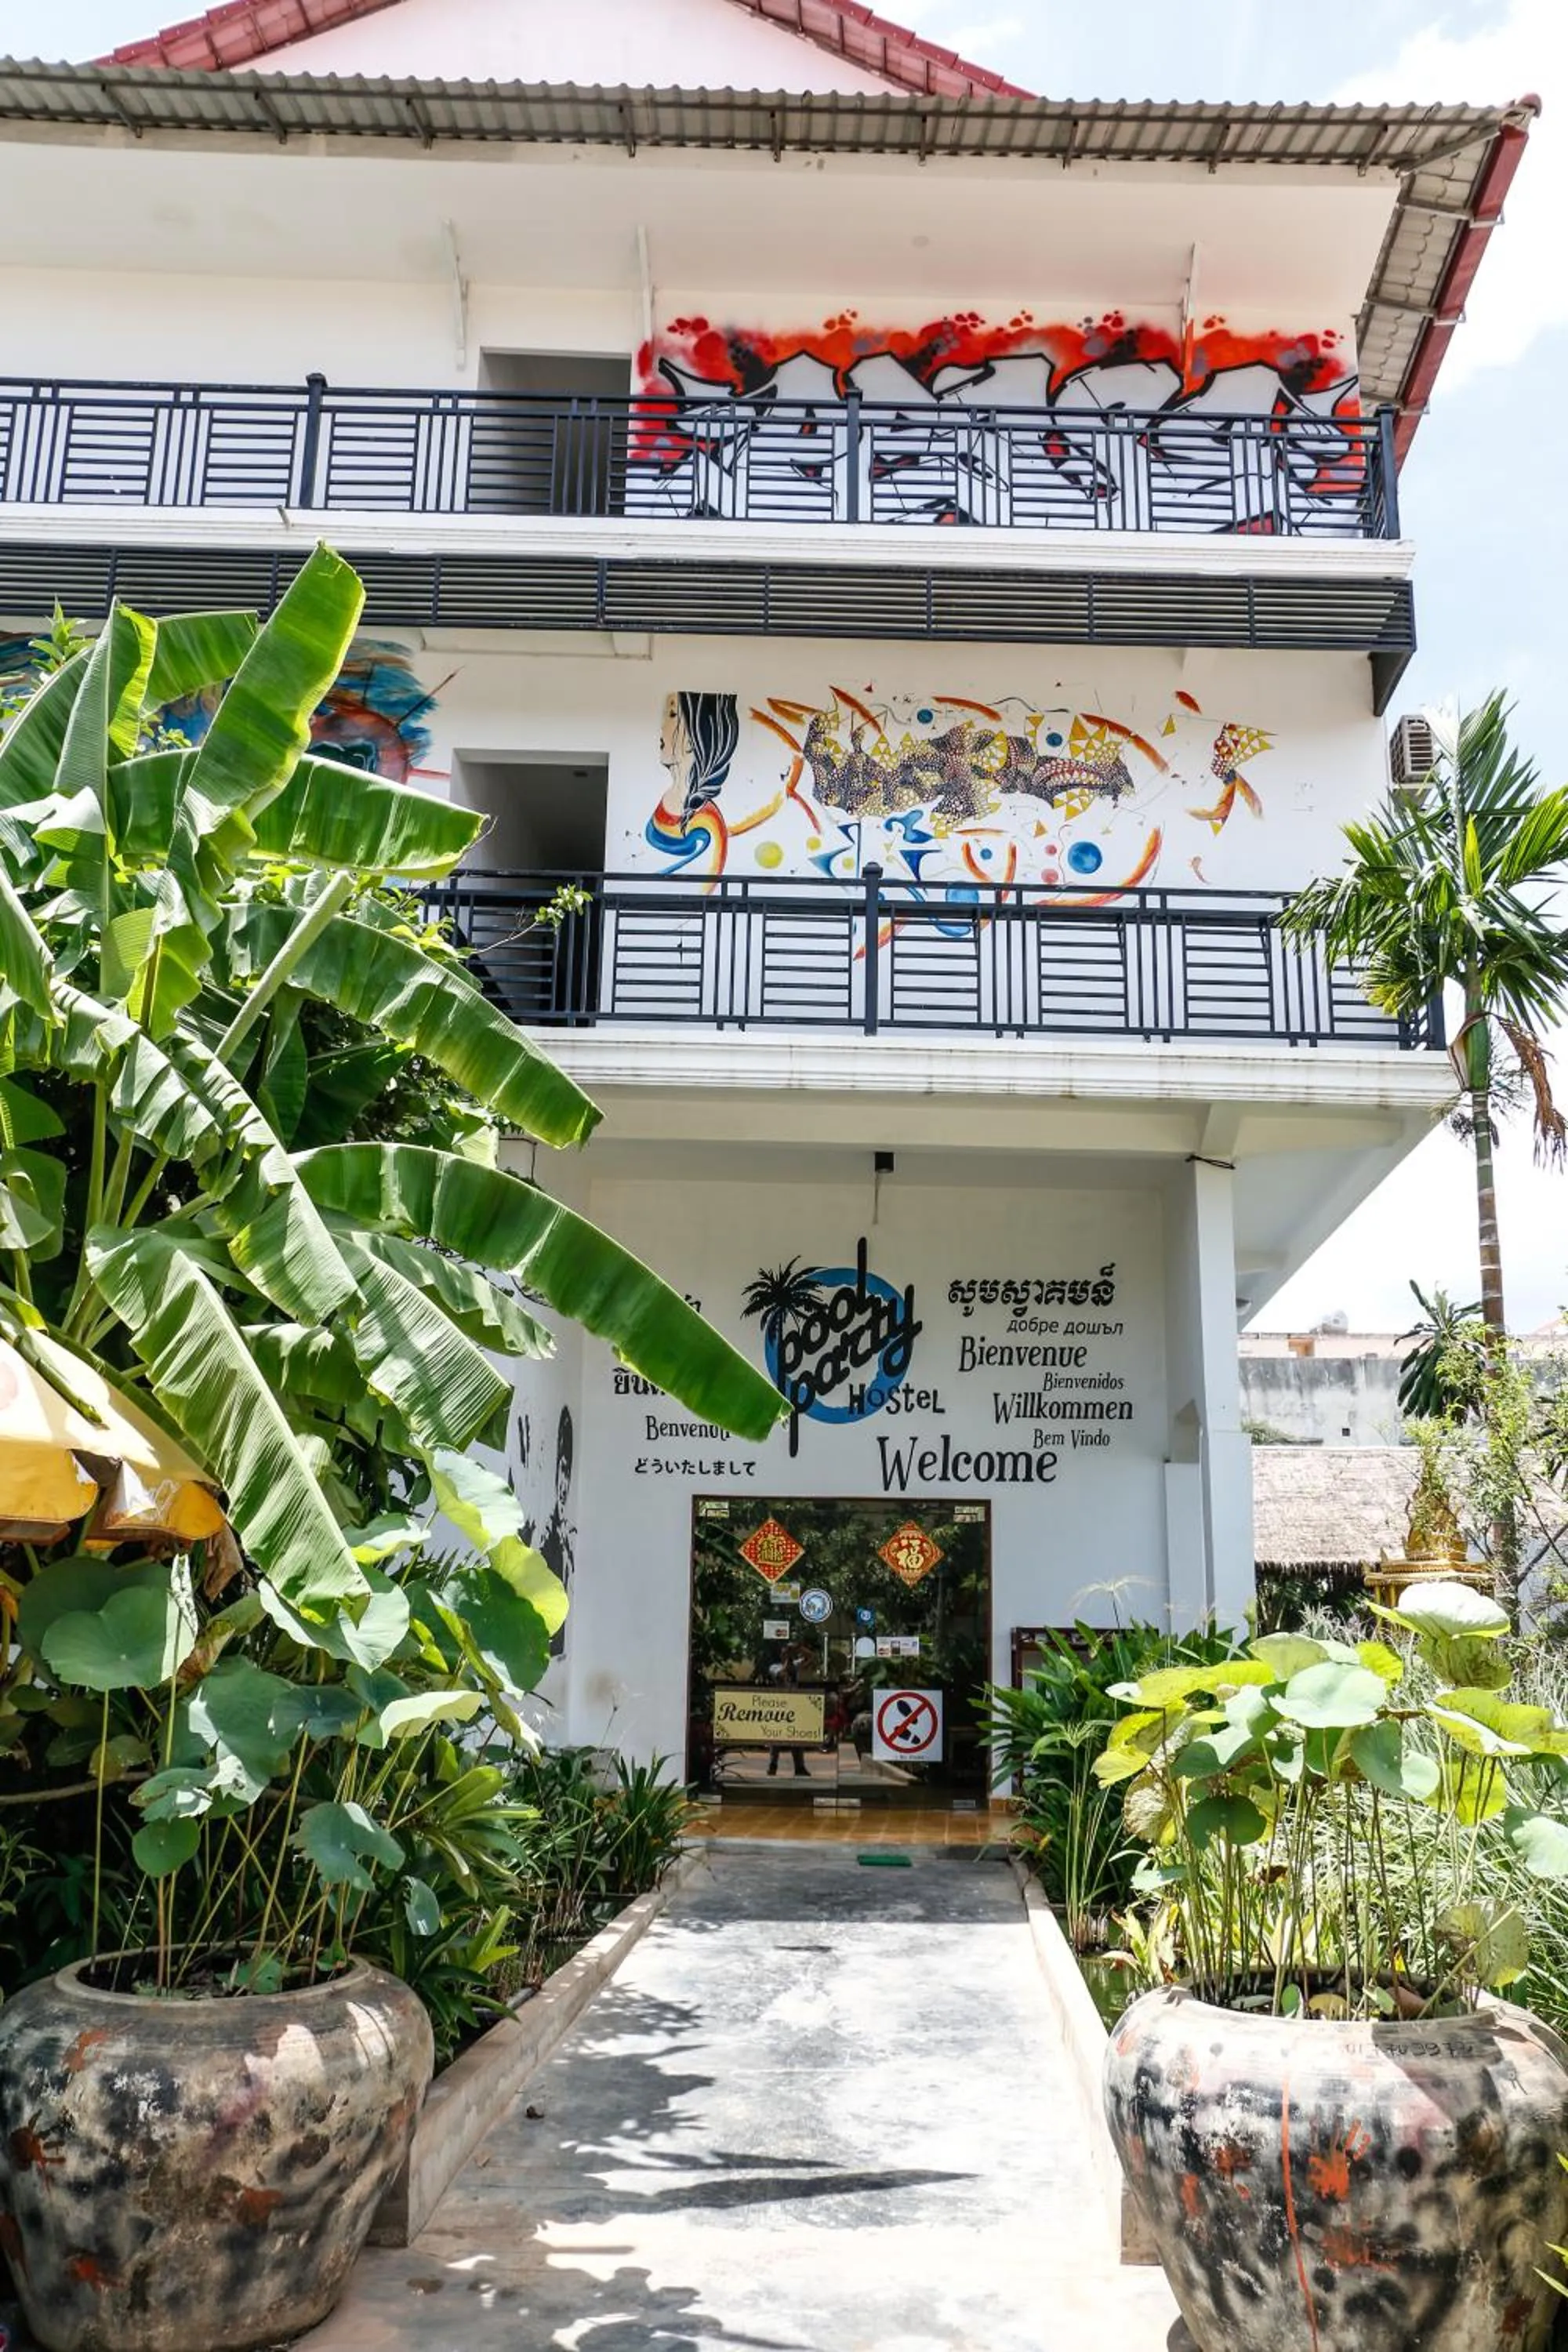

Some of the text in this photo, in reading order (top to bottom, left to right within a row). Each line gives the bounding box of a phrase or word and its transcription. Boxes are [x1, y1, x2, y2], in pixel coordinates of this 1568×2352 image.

[777, 1237, 868, 1394] pool
[1007, 1317, 1059, 1336] добре
[958, 1335, 1087, 1372] Bienvenue
[789, 1284, 923, 1457] party
[1043, 1372, 1124, 1391] Bienvenidos
[993, 1392, 1134, 1424] Willkommen
[1033, 1428, 1110, 1449] Bem Vindo
[634, 1458, 757, 1476] どういたしまして
[877, 1435, 1058, 1491] Welcome
[752, 1695, 787, 1708] Please
[717, 1702, 795, 1722] Remove
[760, 1725, 782, 1737] Your
